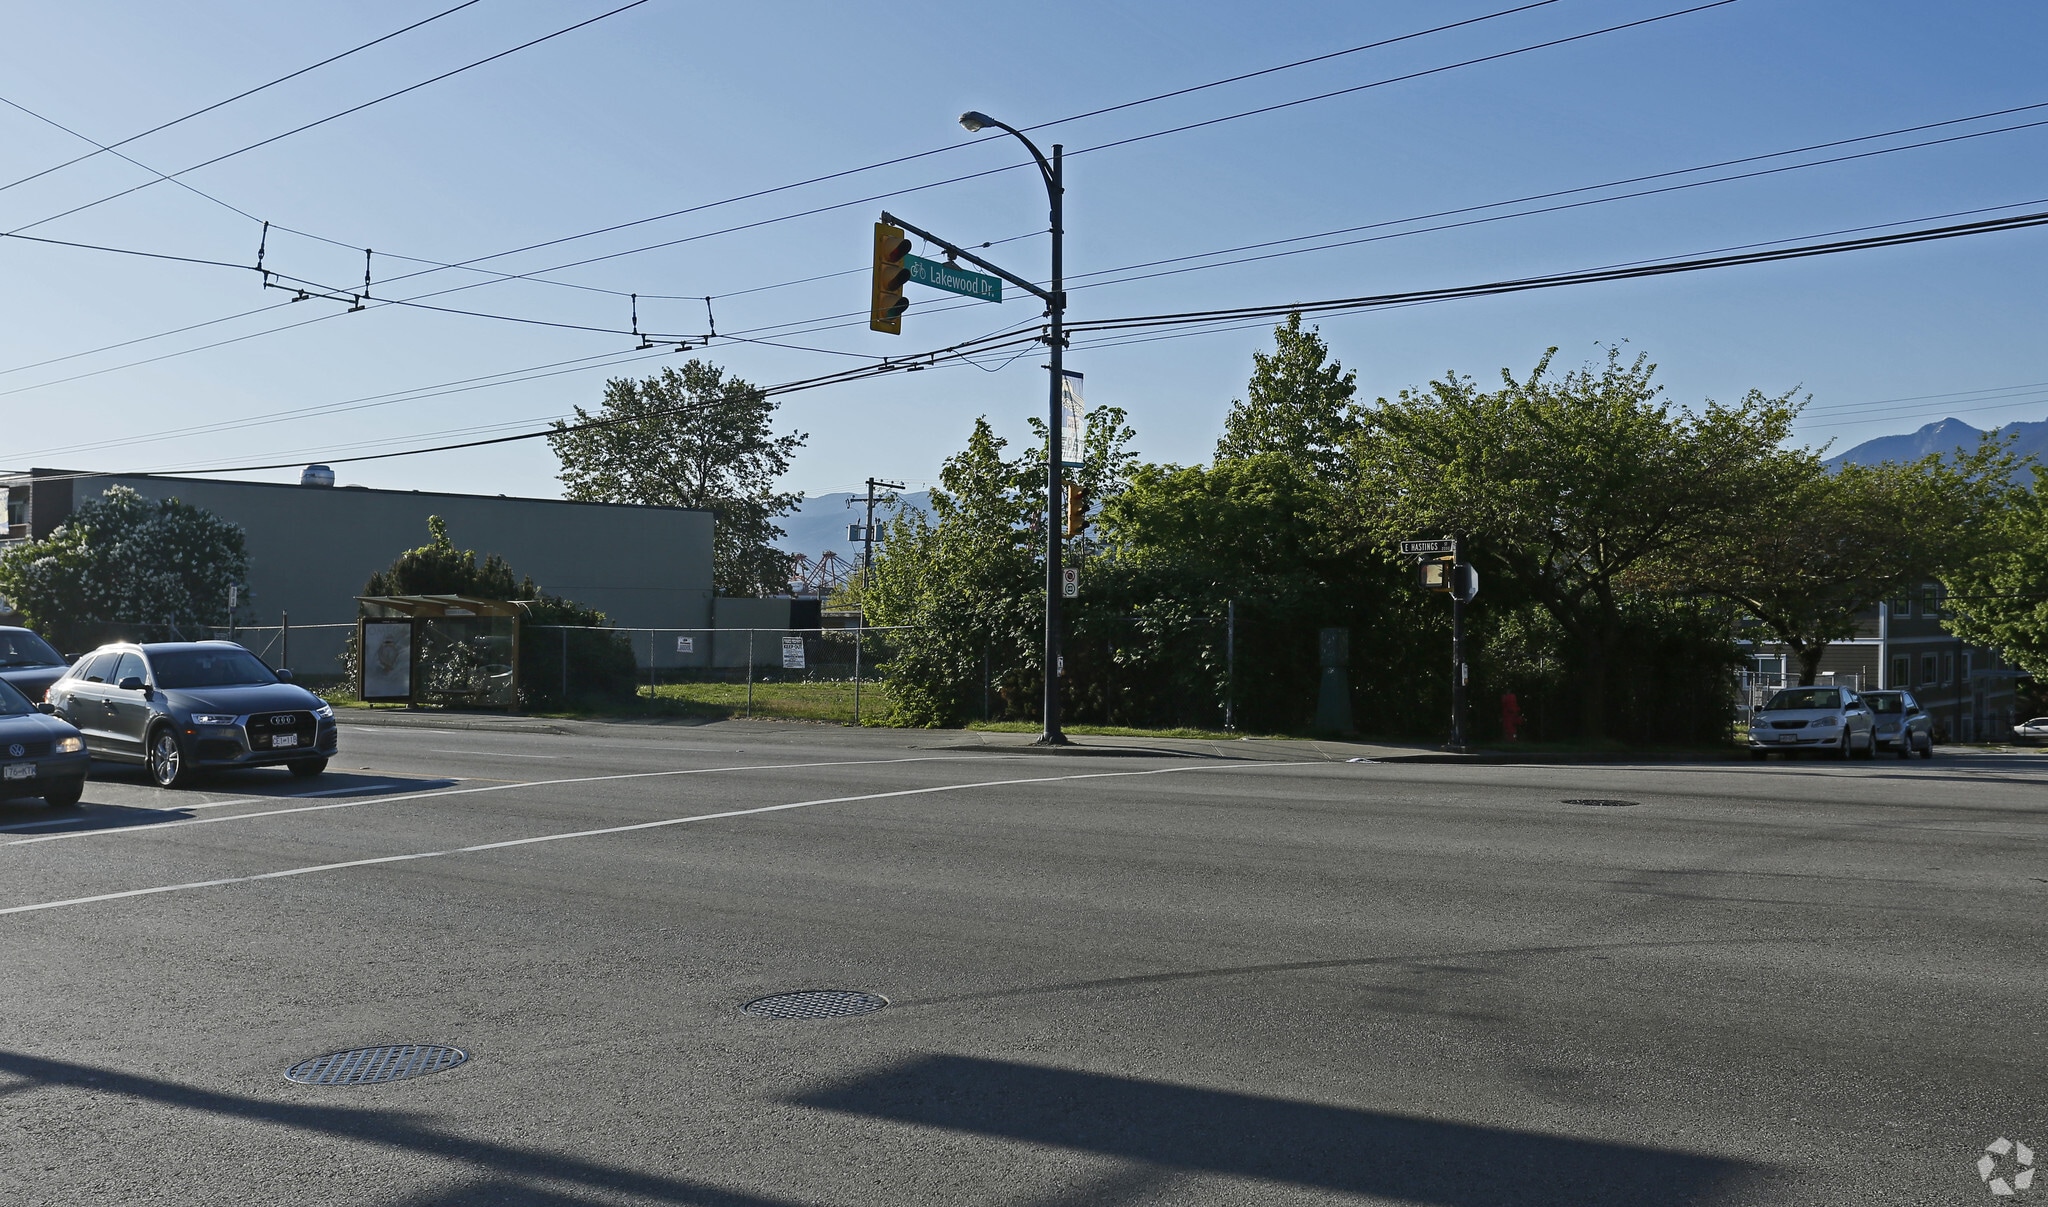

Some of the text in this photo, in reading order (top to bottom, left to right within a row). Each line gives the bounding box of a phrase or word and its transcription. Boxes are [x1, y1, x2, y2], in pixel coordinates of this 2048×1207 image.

[930, 266, 995, 297] Lakewood Dr.
[1405, 542, 1438, 552] E HASTINGS
